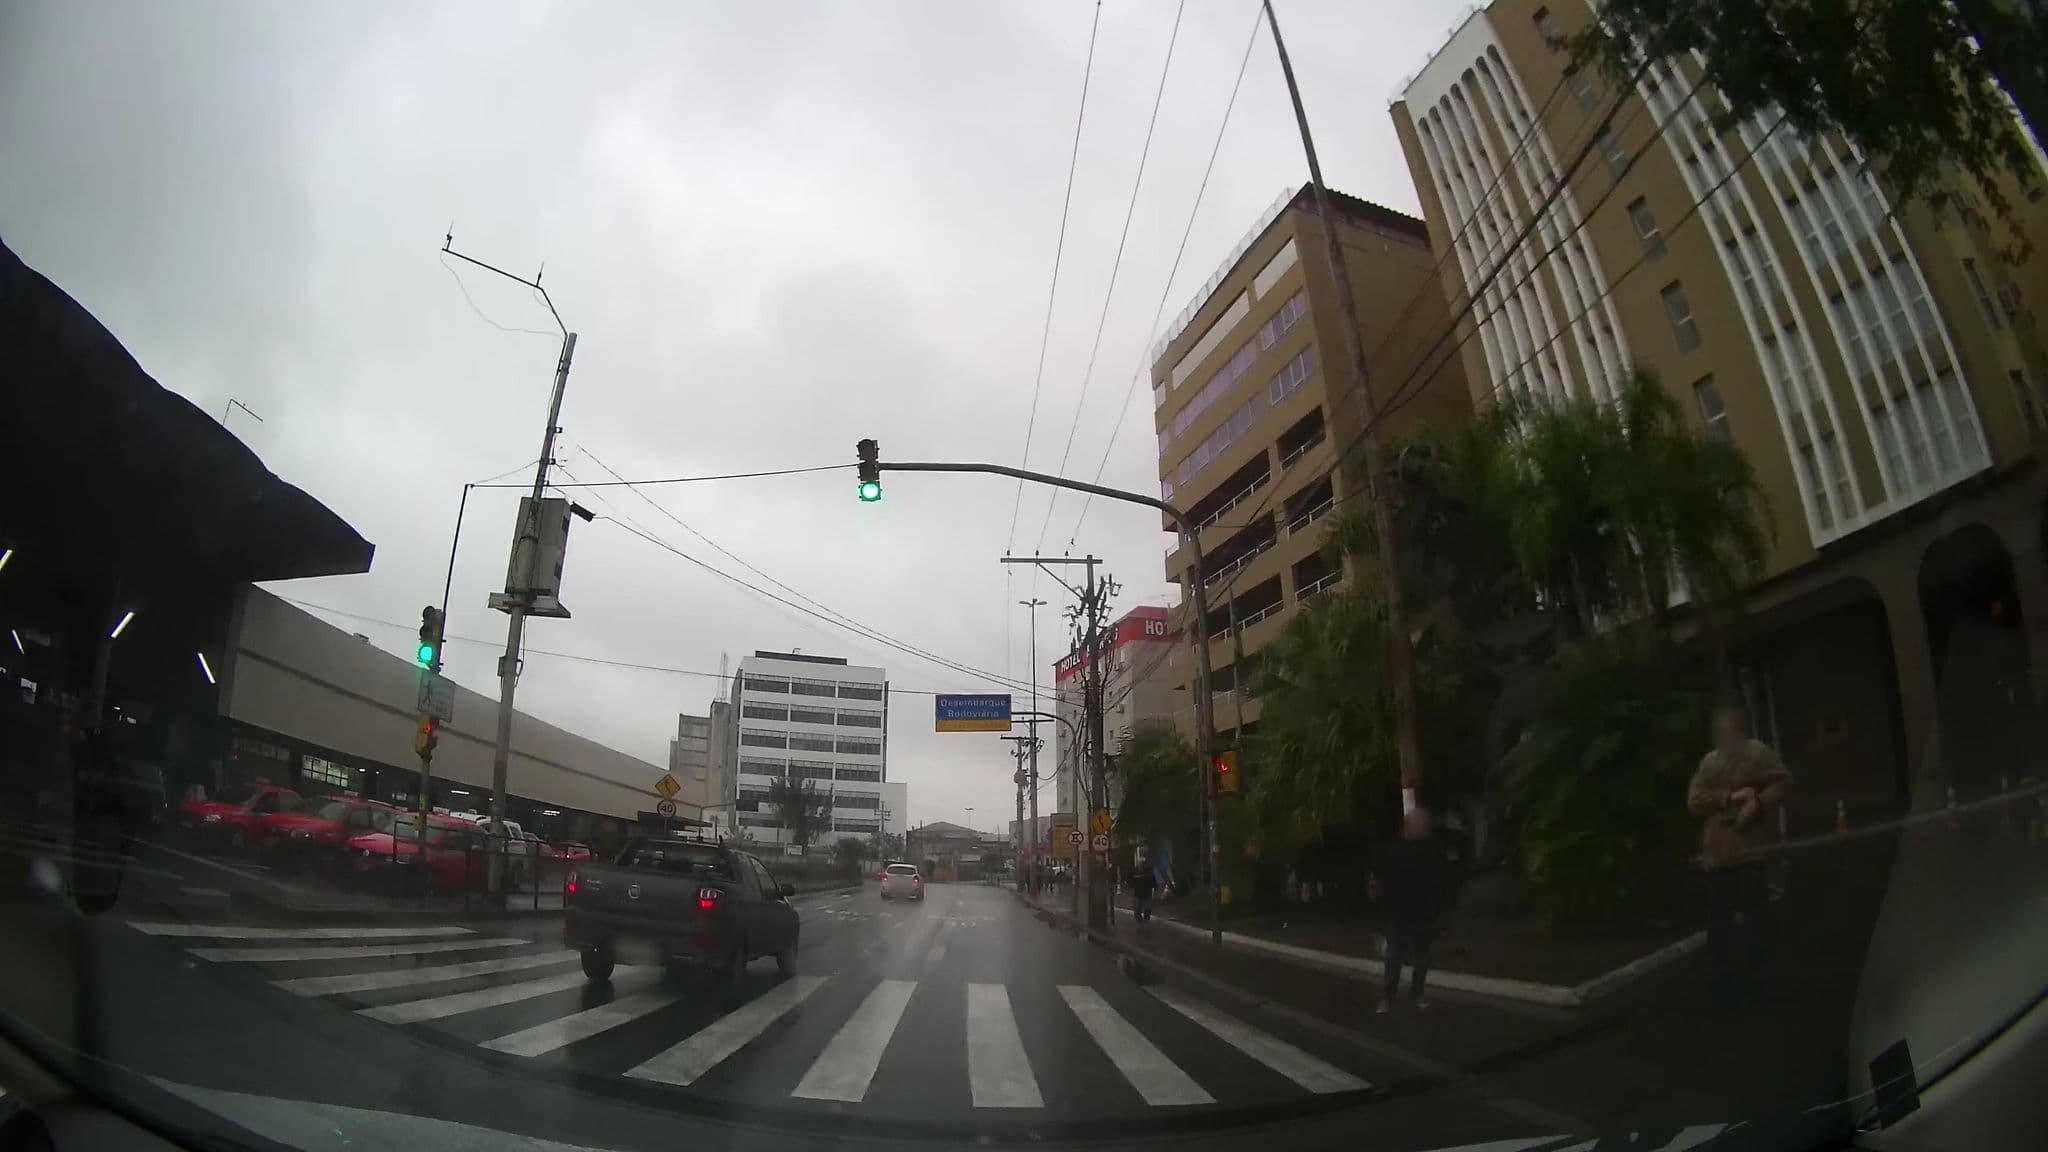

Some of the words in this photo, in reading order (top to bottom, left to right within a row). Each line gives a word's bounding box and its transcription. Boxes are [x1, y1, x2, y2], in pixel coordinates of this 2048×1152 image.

[1145, 619, 1168, 636] HO
[940, 699, 1006, 707] Desembarque
[660, 804, 673, 813] 40
[1095, 837, 1107, 846] 40
